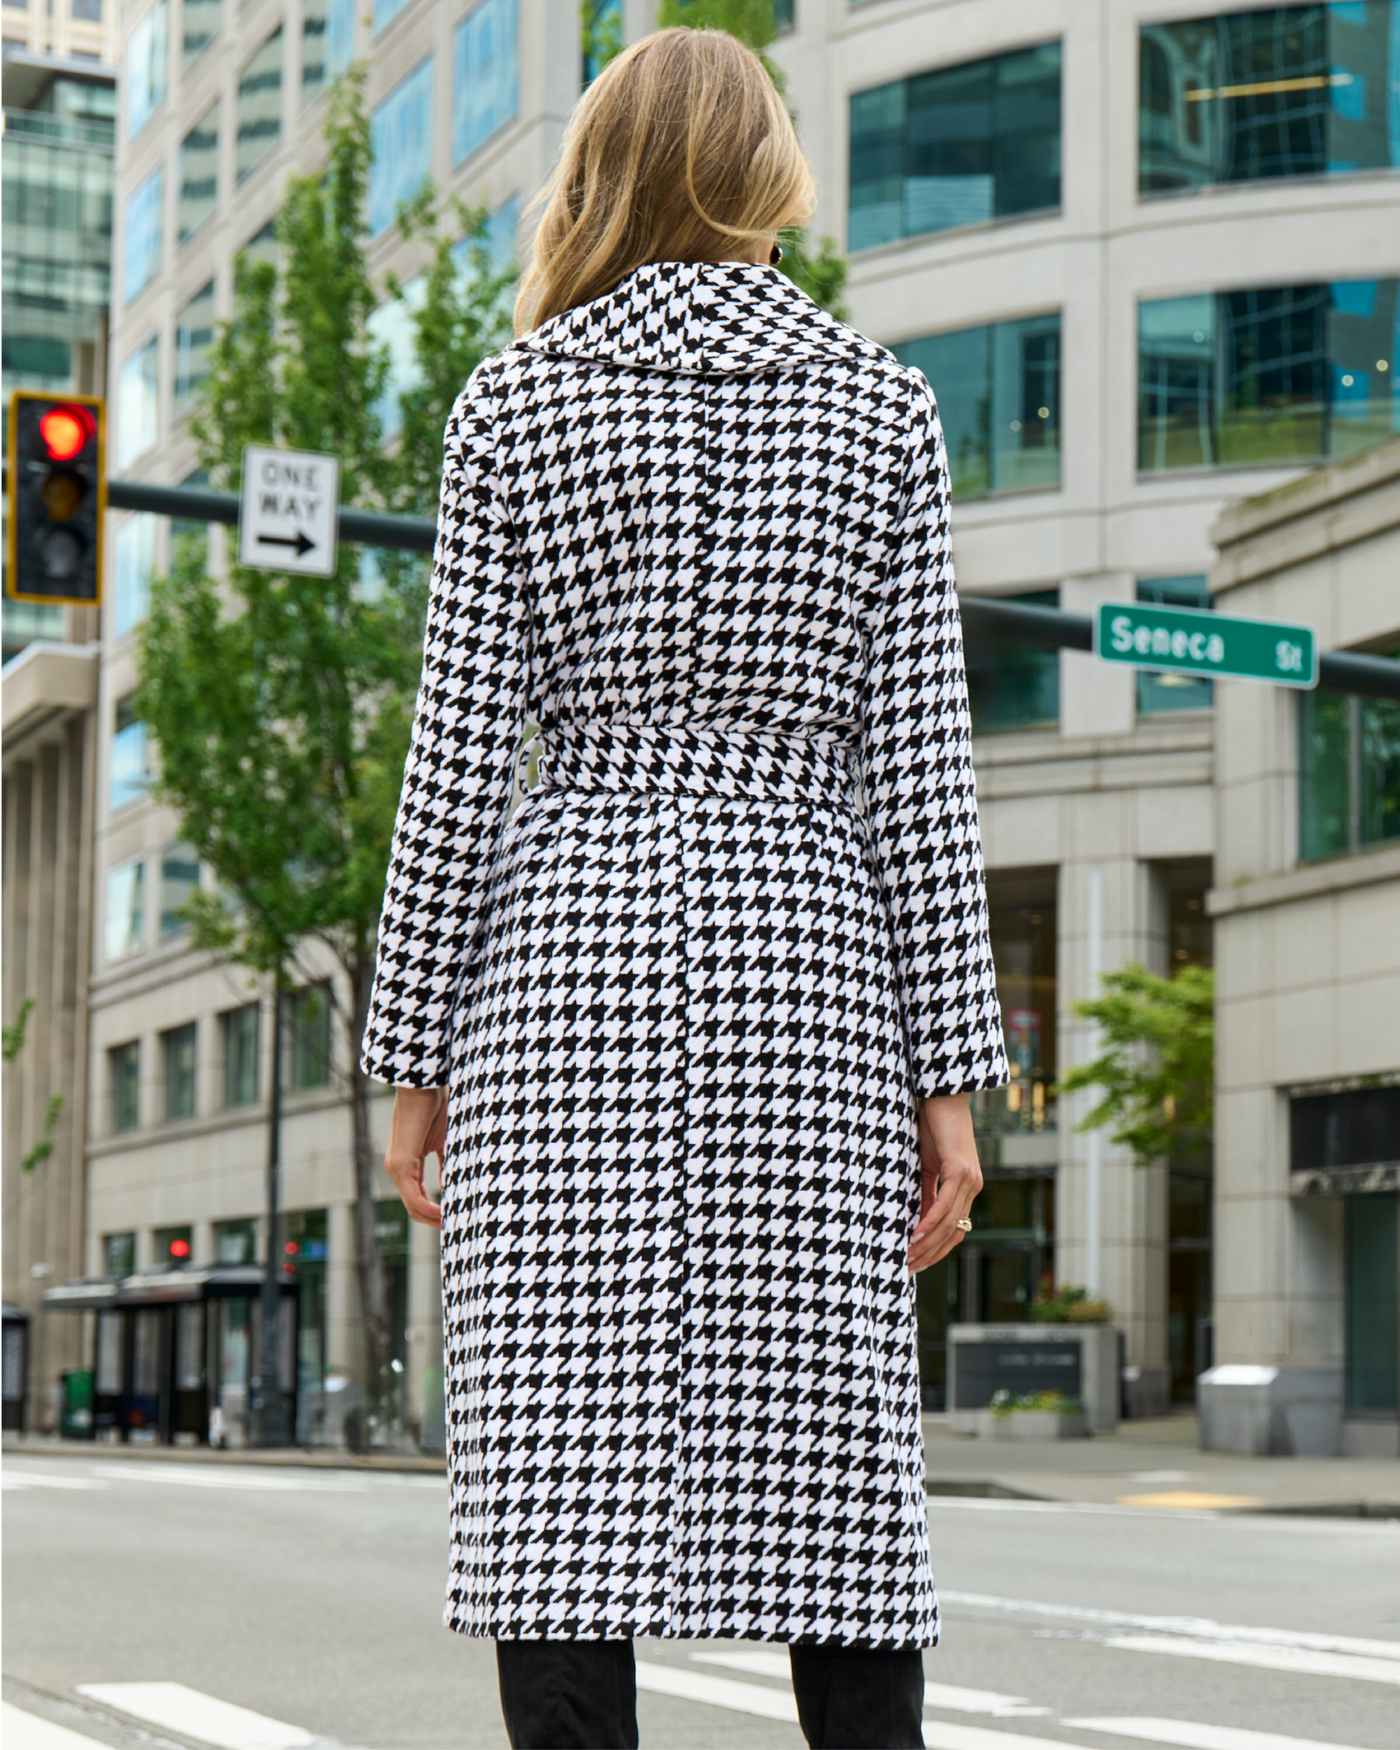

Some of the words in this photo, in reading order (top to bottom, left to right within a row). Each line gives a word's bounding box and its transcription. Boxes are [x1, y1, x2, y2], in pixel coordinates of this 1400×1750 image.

[262, 460, 321, 492] ONE
[259, 492, 322, 522] WAY
[1110, 614, 1225, 663] Seneca
[1275, 639, 1304, 673] St
